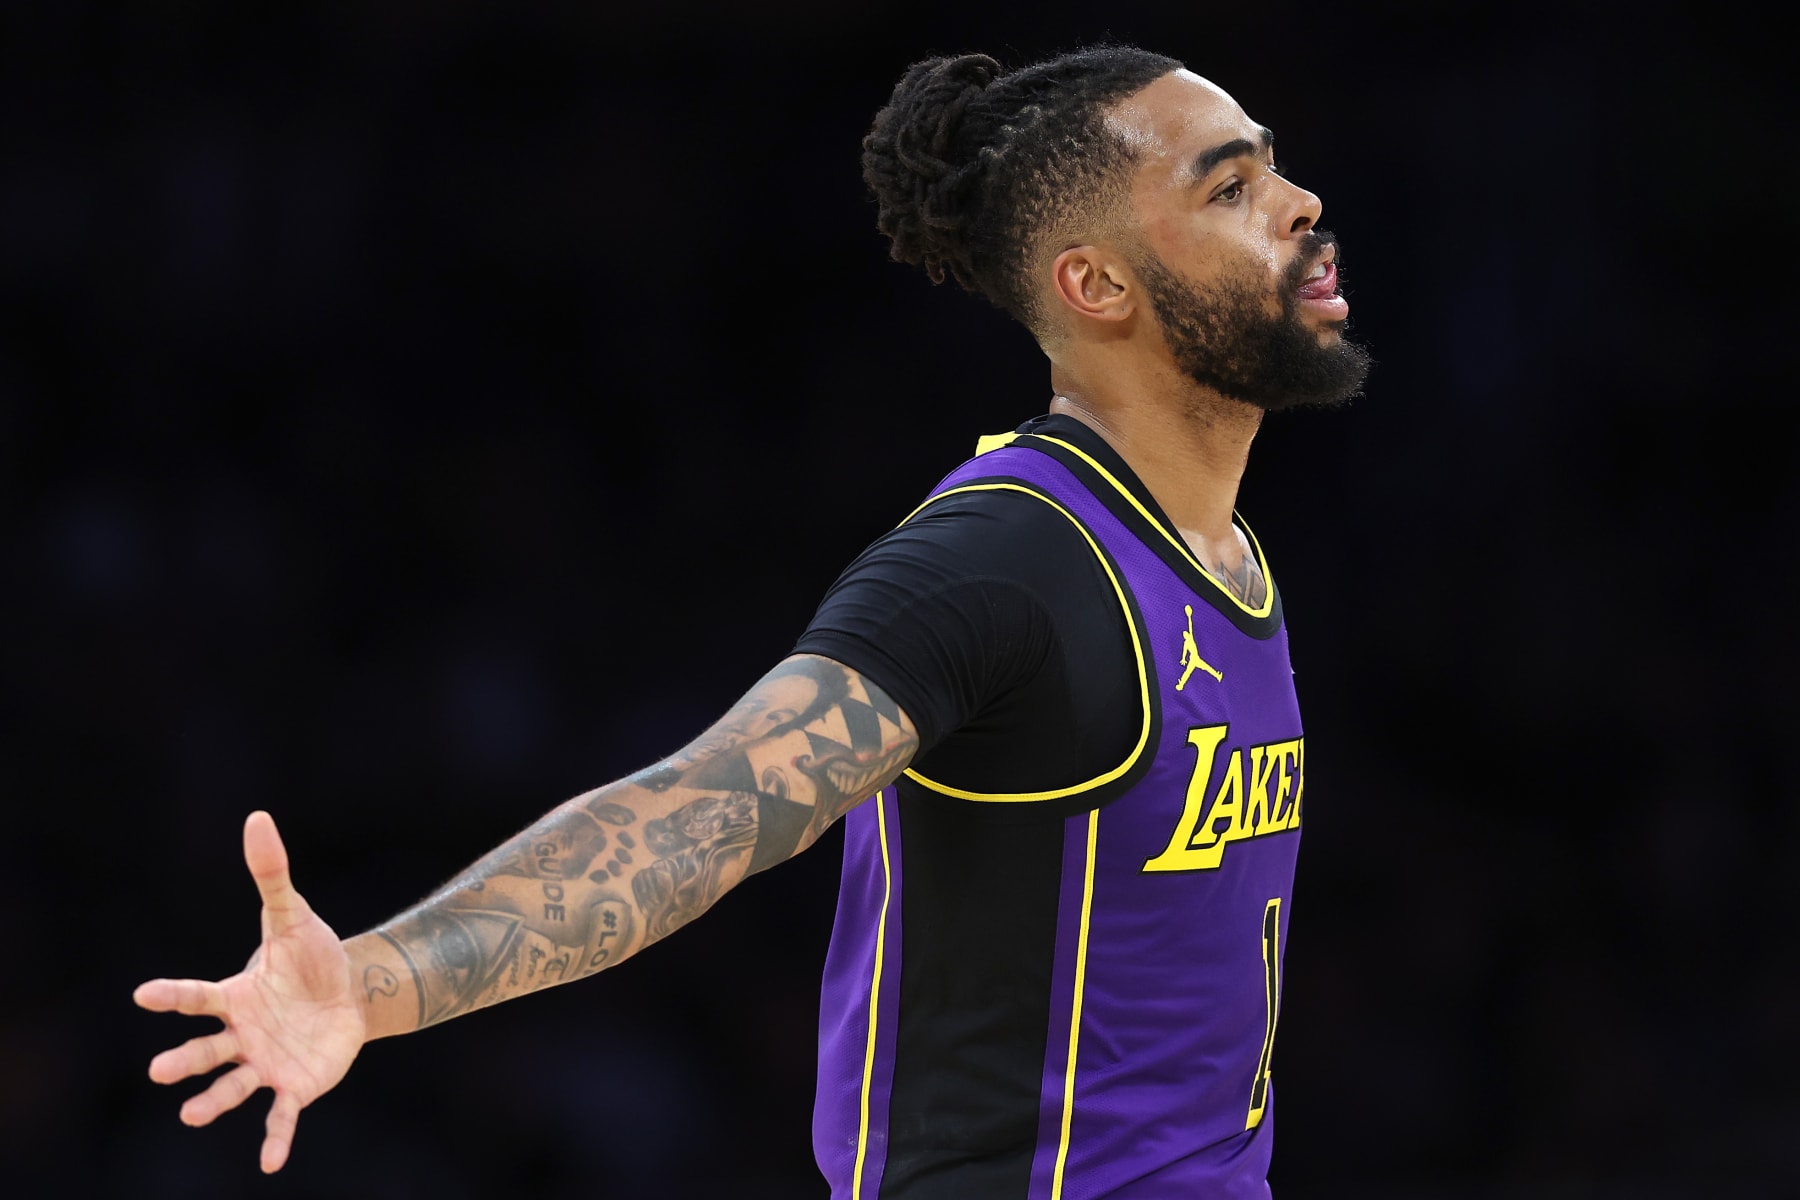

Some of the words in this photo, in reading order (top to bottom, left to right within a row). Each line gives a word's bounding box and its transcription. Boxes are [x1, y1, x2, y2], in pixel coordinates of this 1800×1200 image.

[535, 842, 566, 922] GUIDE
[584, 909, 618, 976] #LO
[1245, 897, 1281, 1131] 1
